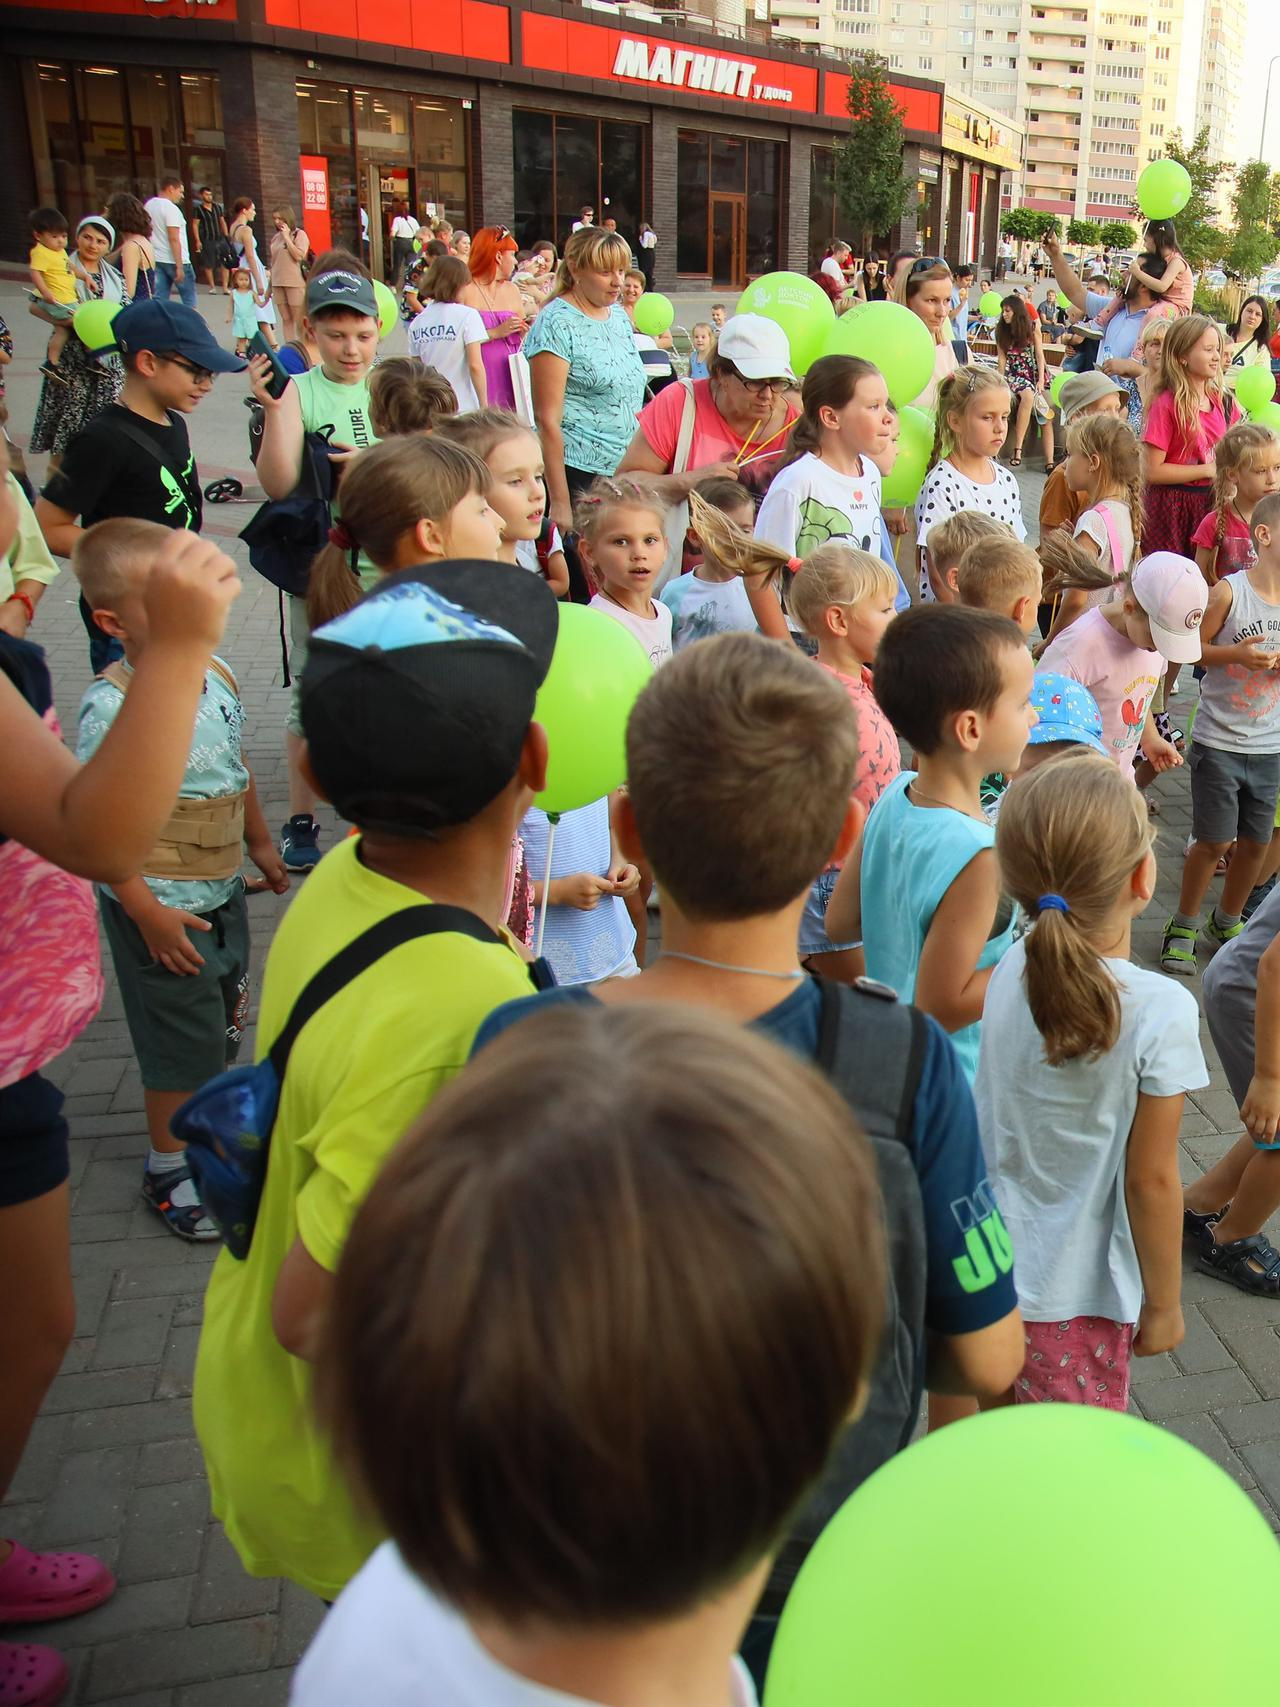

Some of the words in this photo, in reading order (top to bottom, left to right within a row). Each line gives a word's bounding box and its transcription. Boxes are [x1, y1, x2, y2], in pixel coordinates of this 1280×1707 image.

[612, 39, 757, 98] МАГНИТ
[752, 84, 763, 98] у
[763, 86, 793, 102] дома
[412, 325, 456, 341] ШКОЛА
[348, 407, 370, 449] ULTURE
